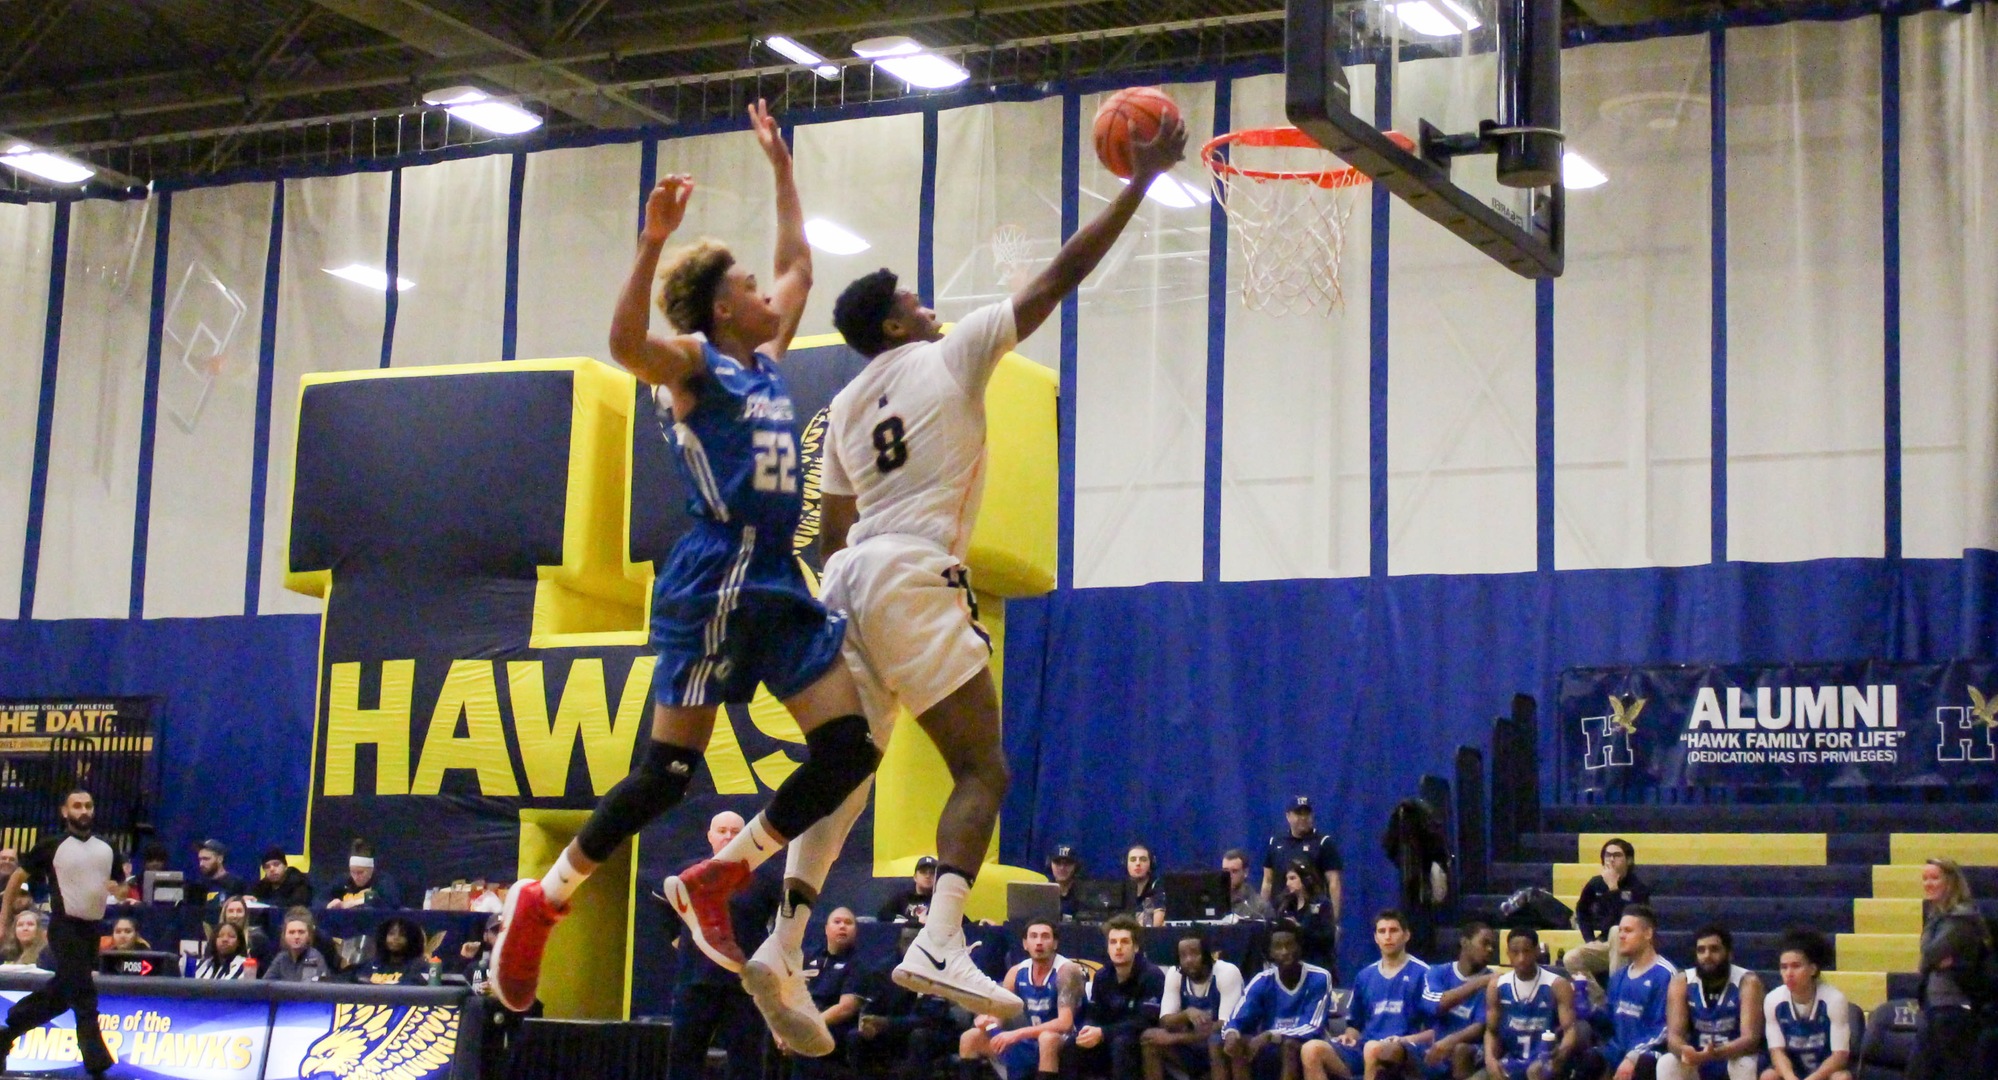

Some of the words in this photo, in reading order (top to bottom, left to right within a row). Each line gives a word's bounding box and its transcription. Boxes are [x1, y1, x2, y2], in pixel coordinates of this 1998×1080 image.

[872, 416, 908, 474] 8
[752, 430, 797, 492] 22
[1688, 684, 1898, 730] ALUMNI
[0, 711, 38, 732] HE
[46, 710, 118, 732] DATE
[1746, 732, 1810, 749] FAMILY
[1815, 732, 1853, 749] FOR
[1687, 751, 1766, 764] (DEDICATION
[1769, 751, 1796, 763] HAS
[1798, 751, 1818, 763] ITS
[1821, 750, 1898, 764] PRIVILEGES)
[123, 961, 142, 972] POSS
[97, 1013, 119, 1031] me
[123, 1011, 143, 1032] of
[144, 1011, 171, 1033] the
[8, 1027, 123, 1064] UMBR
[130, 1032, 252, 1071] HAWKS
